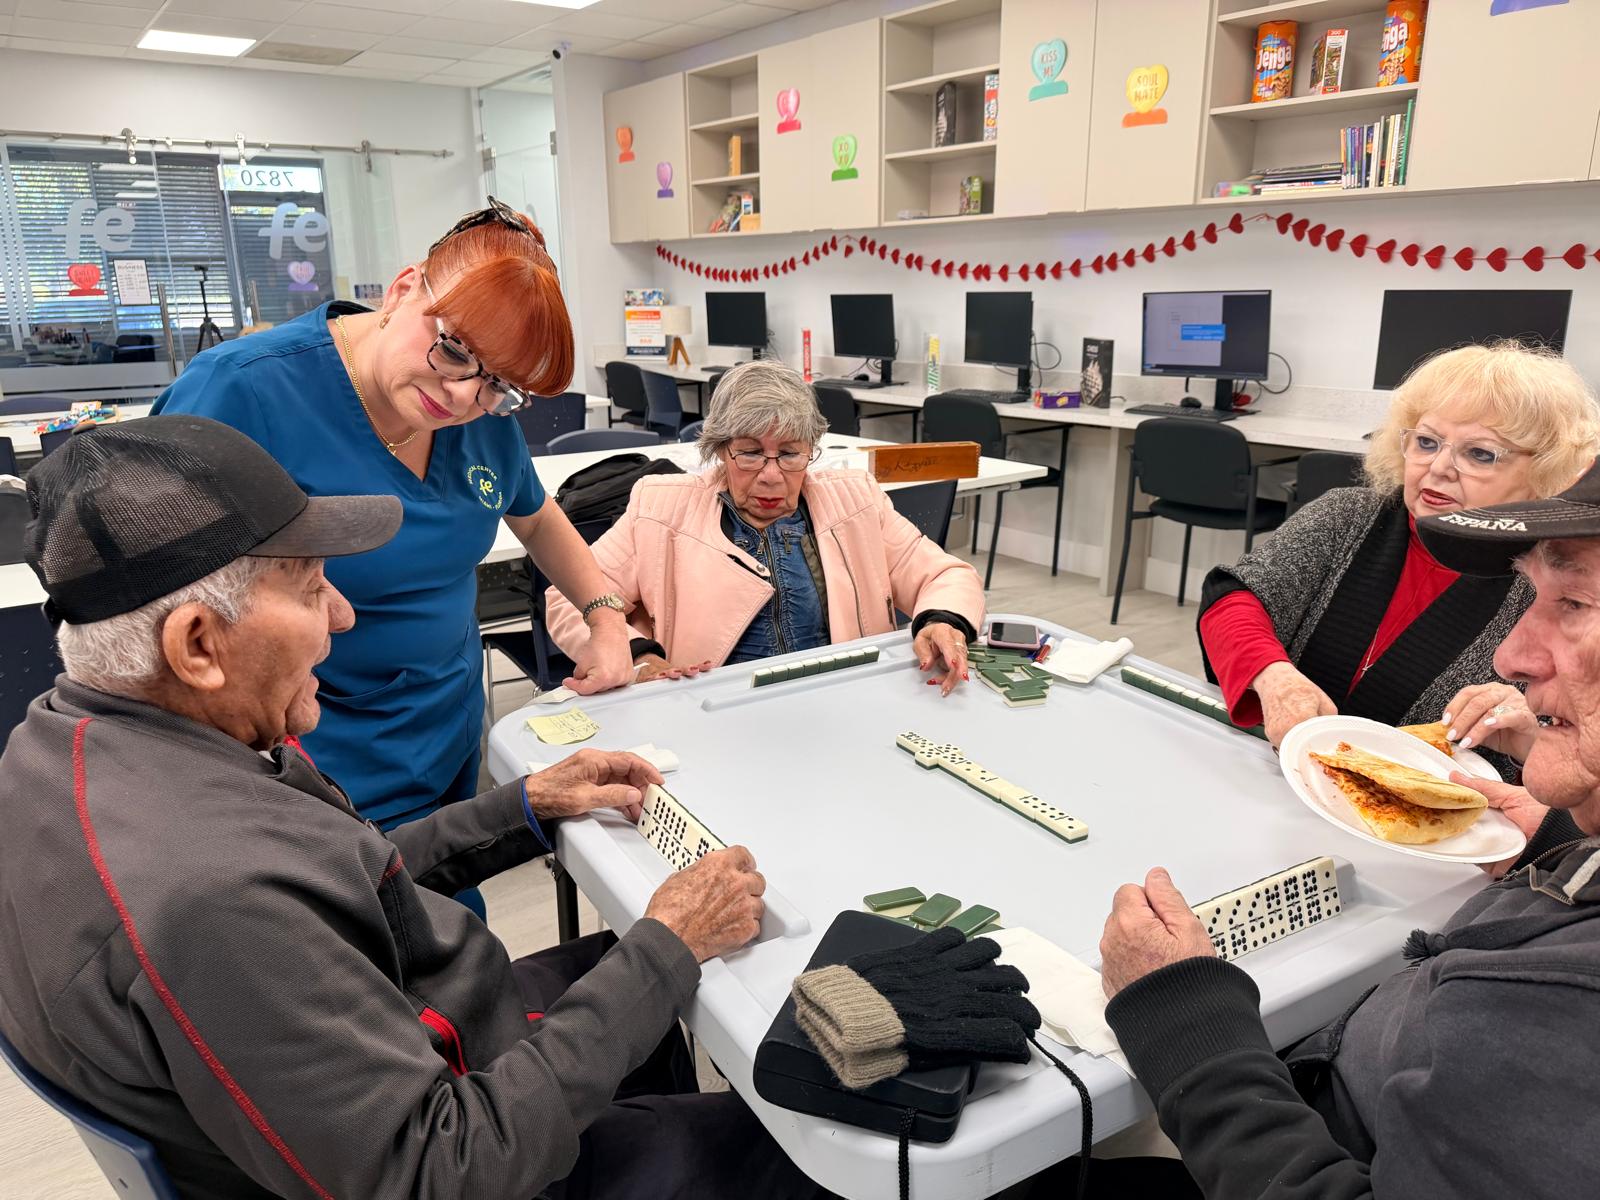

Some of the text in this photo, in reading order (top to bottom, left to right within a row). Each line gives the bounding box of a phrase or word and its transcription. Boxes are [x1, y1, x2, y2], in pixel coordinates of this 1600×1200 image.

[1041, 49, 1058, 64] KISS
[1256, 44, 1292, 71] Jenga
[1043, 65, 1054, 78] ME
[1136, 72, 1159, 87] SOUL
[1134, 87, 1159, 102] MATE
[51, 199, 136, 260] fe
[258, 202, 328, 259] fe
[479, 478, 494, 496] fe
